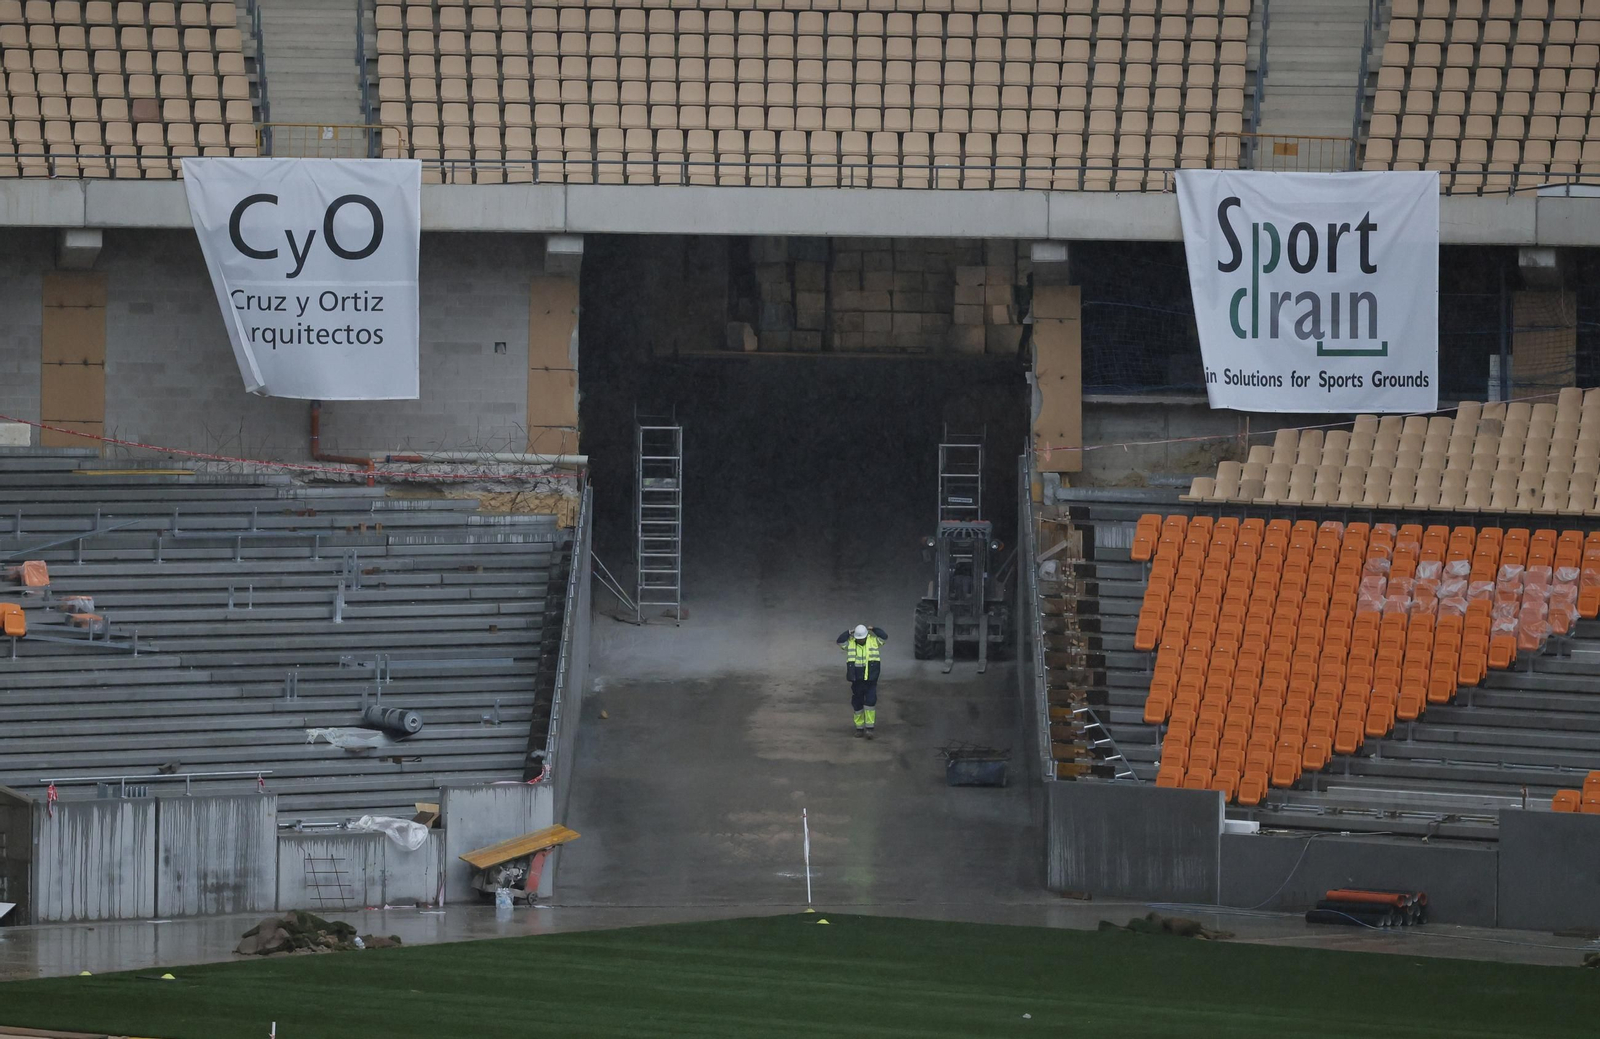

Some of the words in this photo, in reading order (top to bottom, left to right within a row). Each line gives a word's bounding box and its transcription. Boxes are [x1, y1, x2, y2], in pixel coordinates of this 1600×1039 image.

[228, 193, 385, 279] CyO
[1217, 196, 1378, 277] Sport
[230, 289, 287, 312] Cruz
[295, 295, 310, 318] y
[318, 290, 385, 312] Ortiz
[1227, 268, 1378, 342] drain
[243, 322, 384, 350] rquitectos
[1223, 367, 1284, 388] Solutions
[1290, 369, 1311, 388] for
[1318, 369, 1364, 393] Sports
[1371, 370, 1430, 388] Grounds
